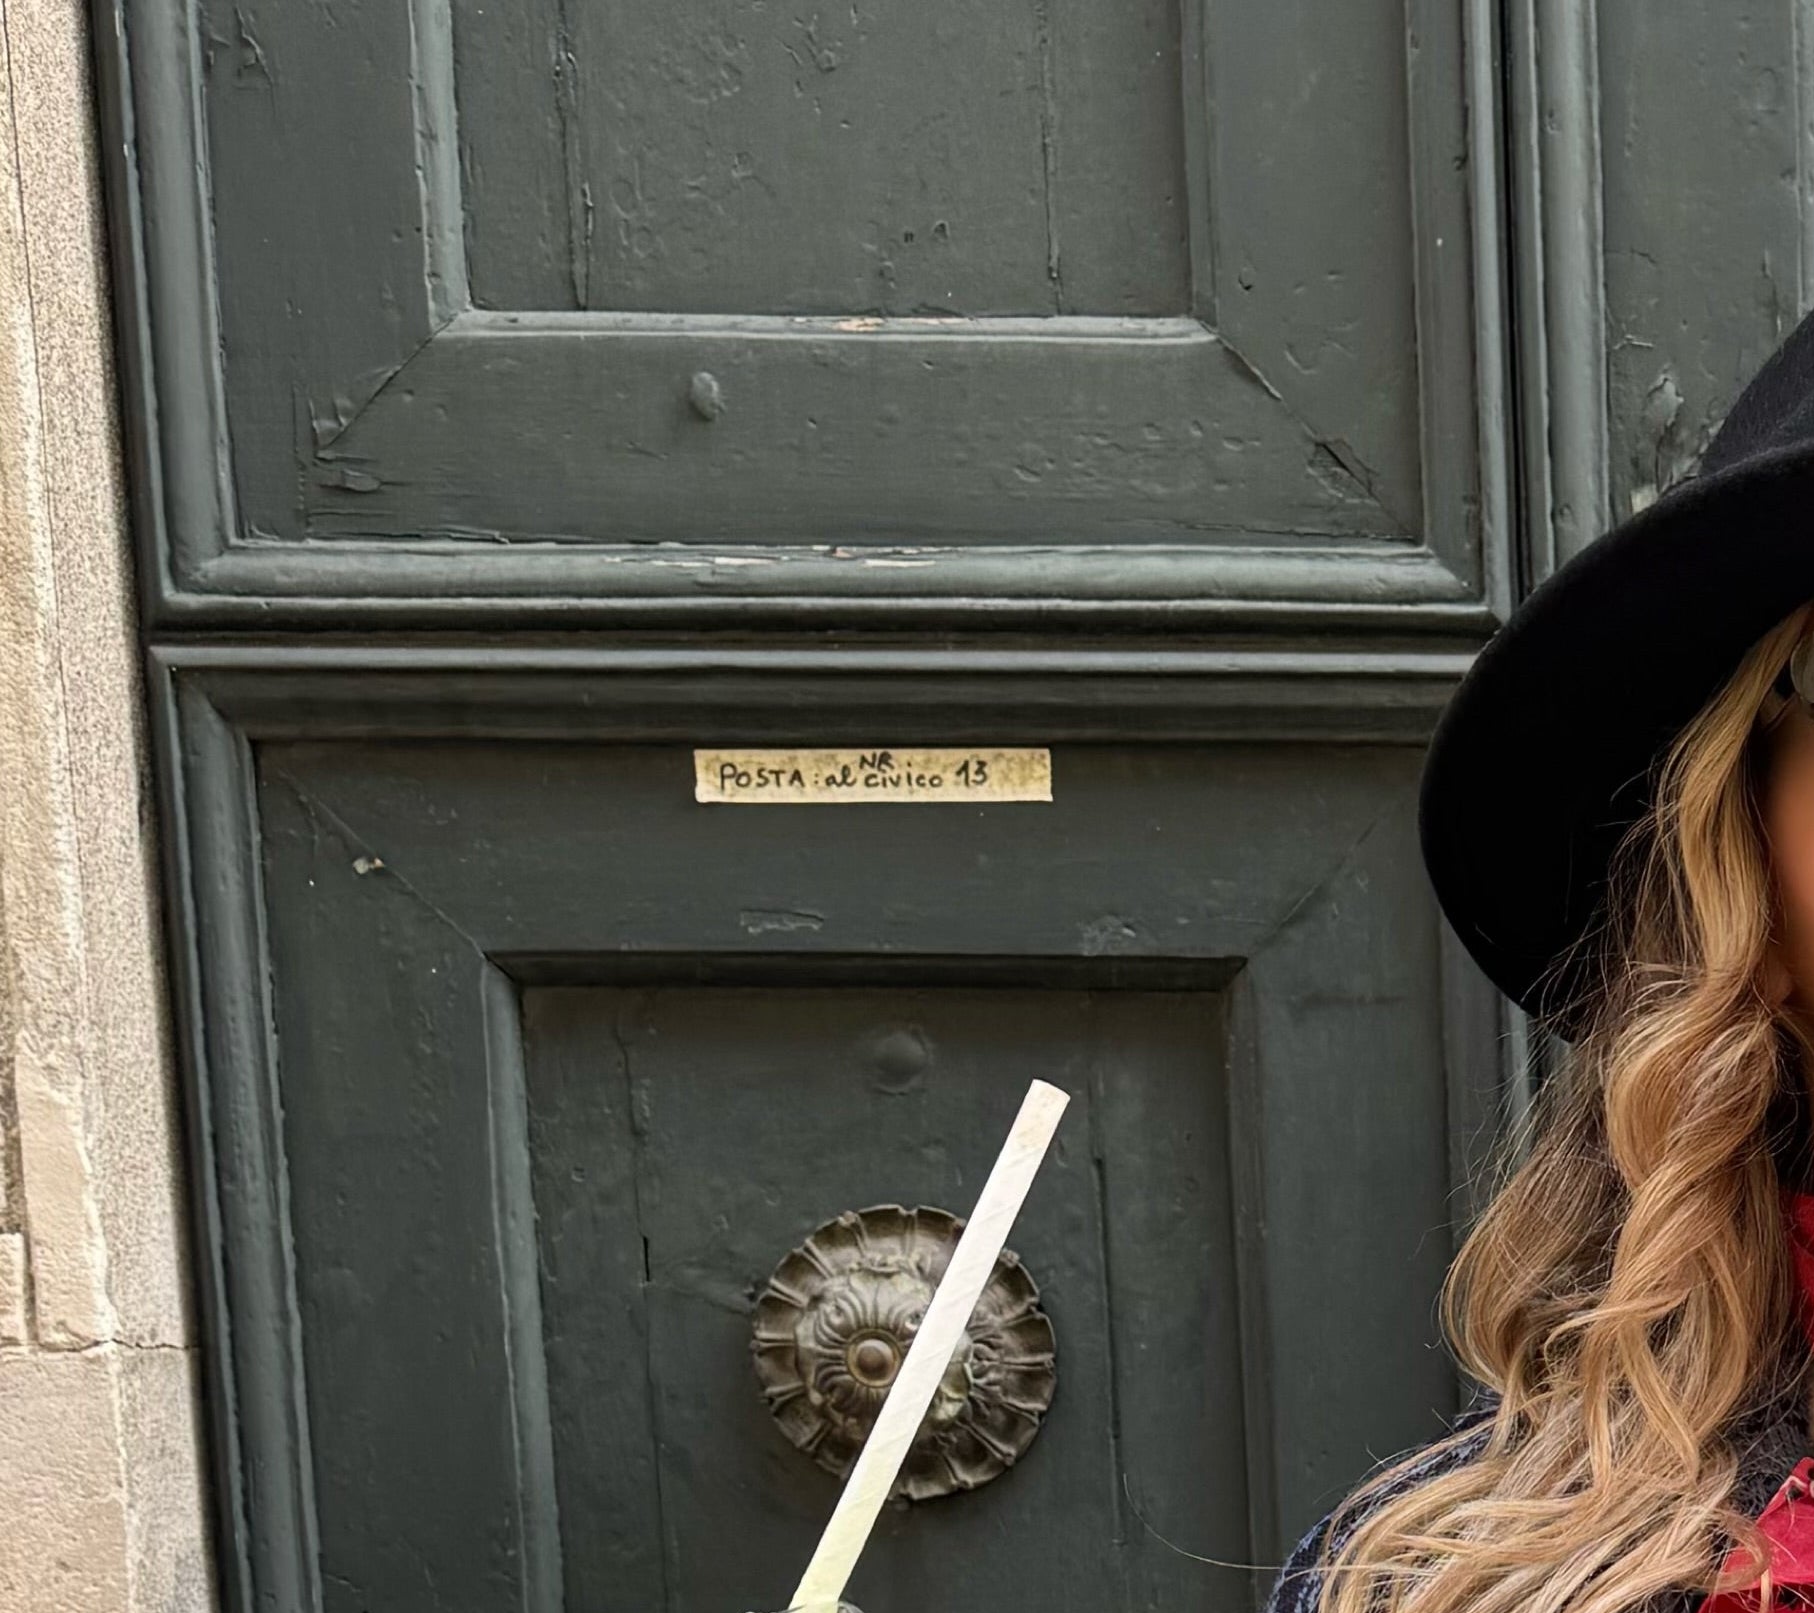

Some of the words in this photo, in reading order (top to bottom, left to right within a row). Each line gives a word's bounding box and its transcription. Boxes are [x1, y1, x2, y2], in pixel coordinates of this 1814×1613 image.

[859, 751, 894, 771] NR
[825, 768, 857, 788] al
[863, 761, 944, 789] civico
[954, 759, 988, 787] 13
